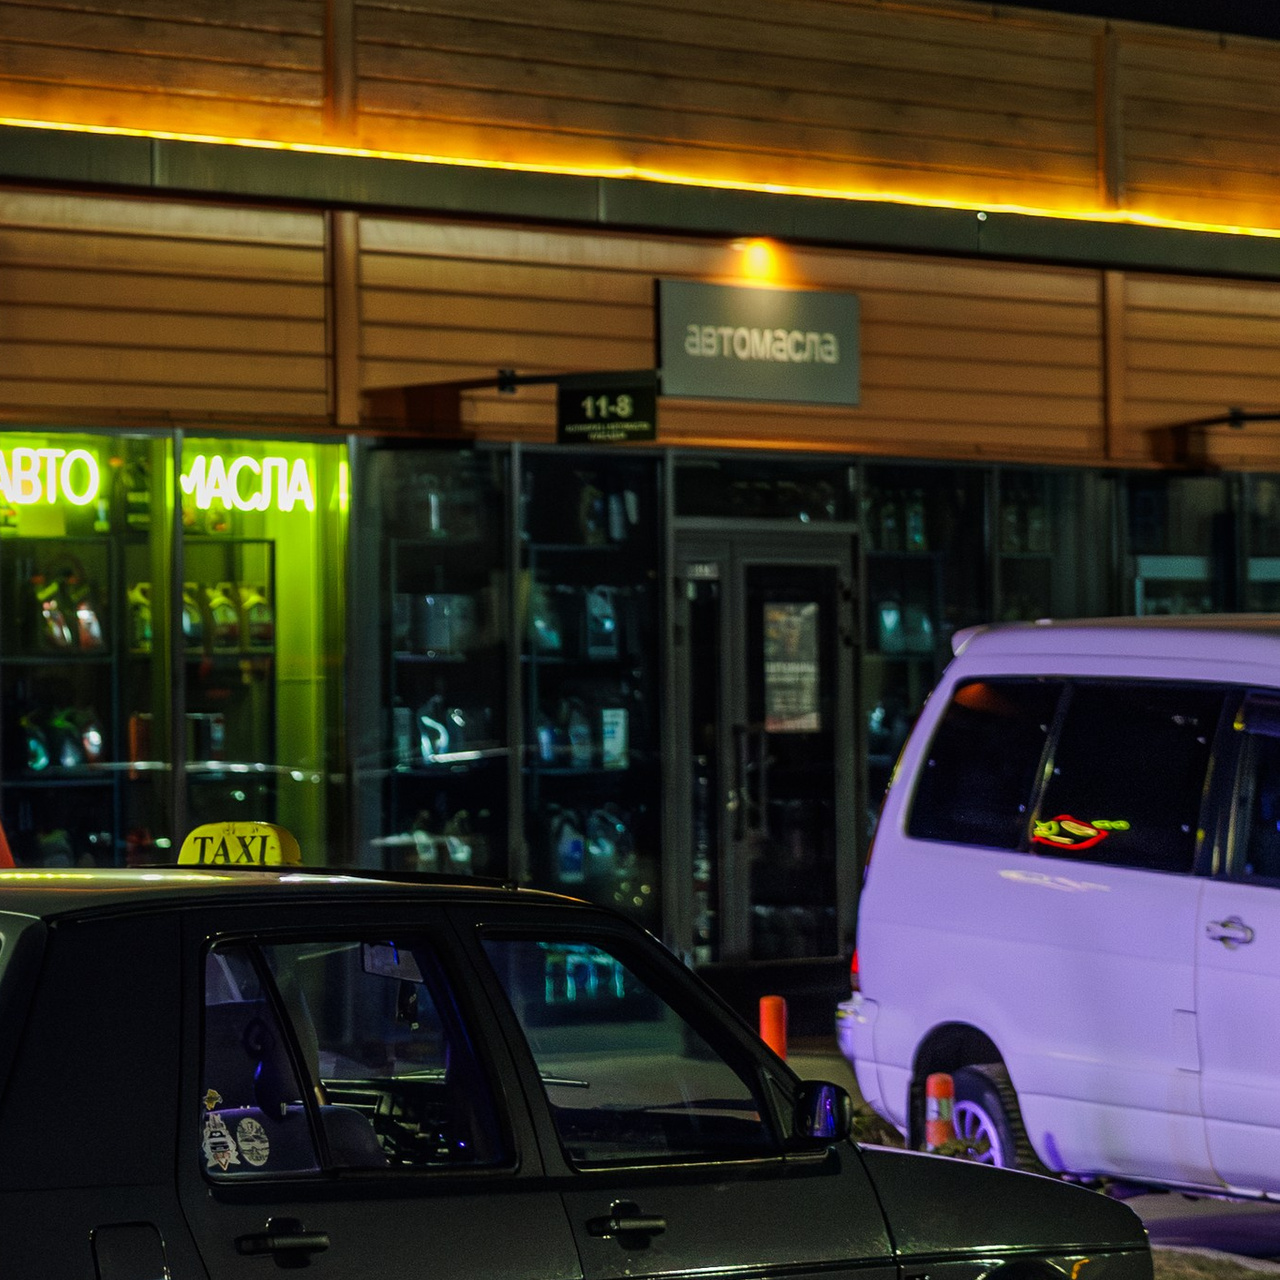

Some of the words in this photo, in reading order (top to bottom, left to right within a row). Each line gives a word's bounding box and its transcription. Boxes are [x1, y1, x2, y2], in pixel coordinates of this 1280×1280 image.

[684, 324, 840, 364] автомасла
[581, 394, 634, 419] 11-8
[193, 835, 271, 866] TAXI
